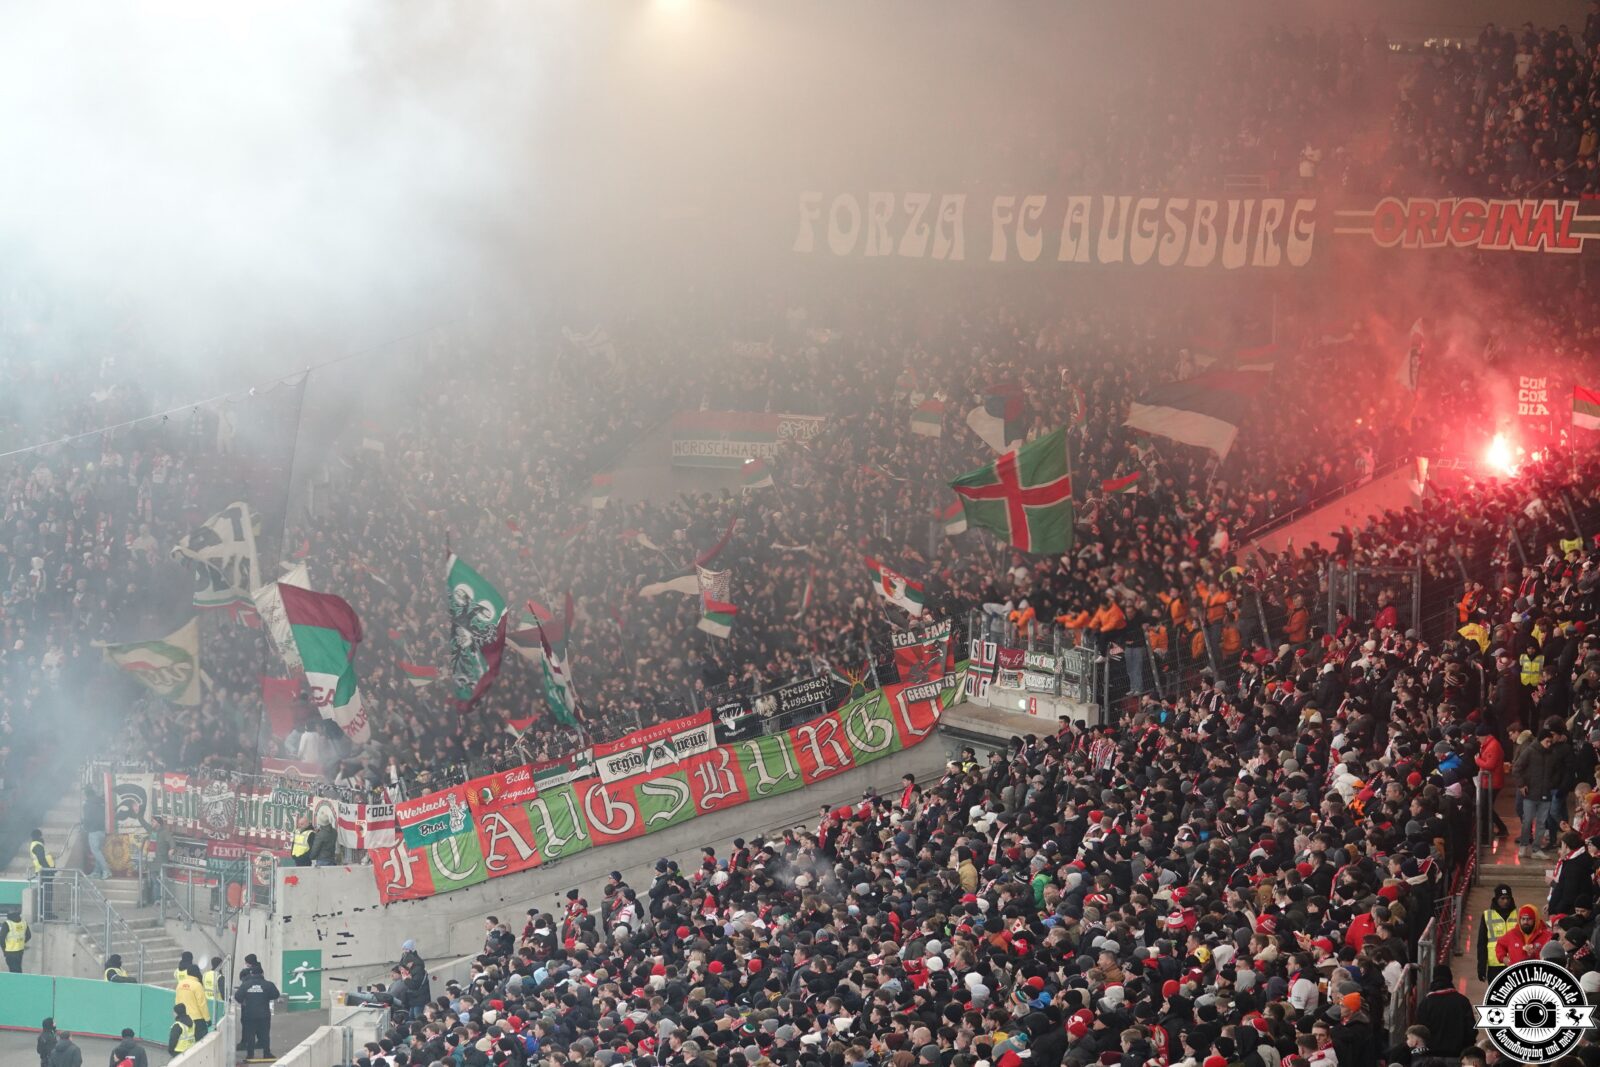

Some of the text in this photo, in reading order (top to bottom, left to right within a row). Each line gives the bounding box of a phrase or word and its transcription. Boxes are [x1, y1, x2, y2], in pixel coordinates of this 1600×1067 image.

[792, 192, 1317, 270] FORZA FC AUGSBURG
[1372, 198, 1582, 251] ORIGINAL
[1519, 376, 1547, 389] CON
[1518, 389, 1548, 402] COR
[1518, 402, 1549, 415] DIA
[674, 441, 775, 457] NORDSCHWABEN
[891, 632, 916, 647] FCA
[924, 619, 951, 639] FANS
[778, 676, 830, 700] Preussen
[906, 682, 937, 702] GEGEN
[608, 751, 644, 775] regio
[675, 730, 709, 752] neun
[505, 770, 531, 785] Bella
[500, 787, 536, 802] Augusta
[397, 798, 447, 821] Wertach
[419, 822, 447, 837] Bros.
